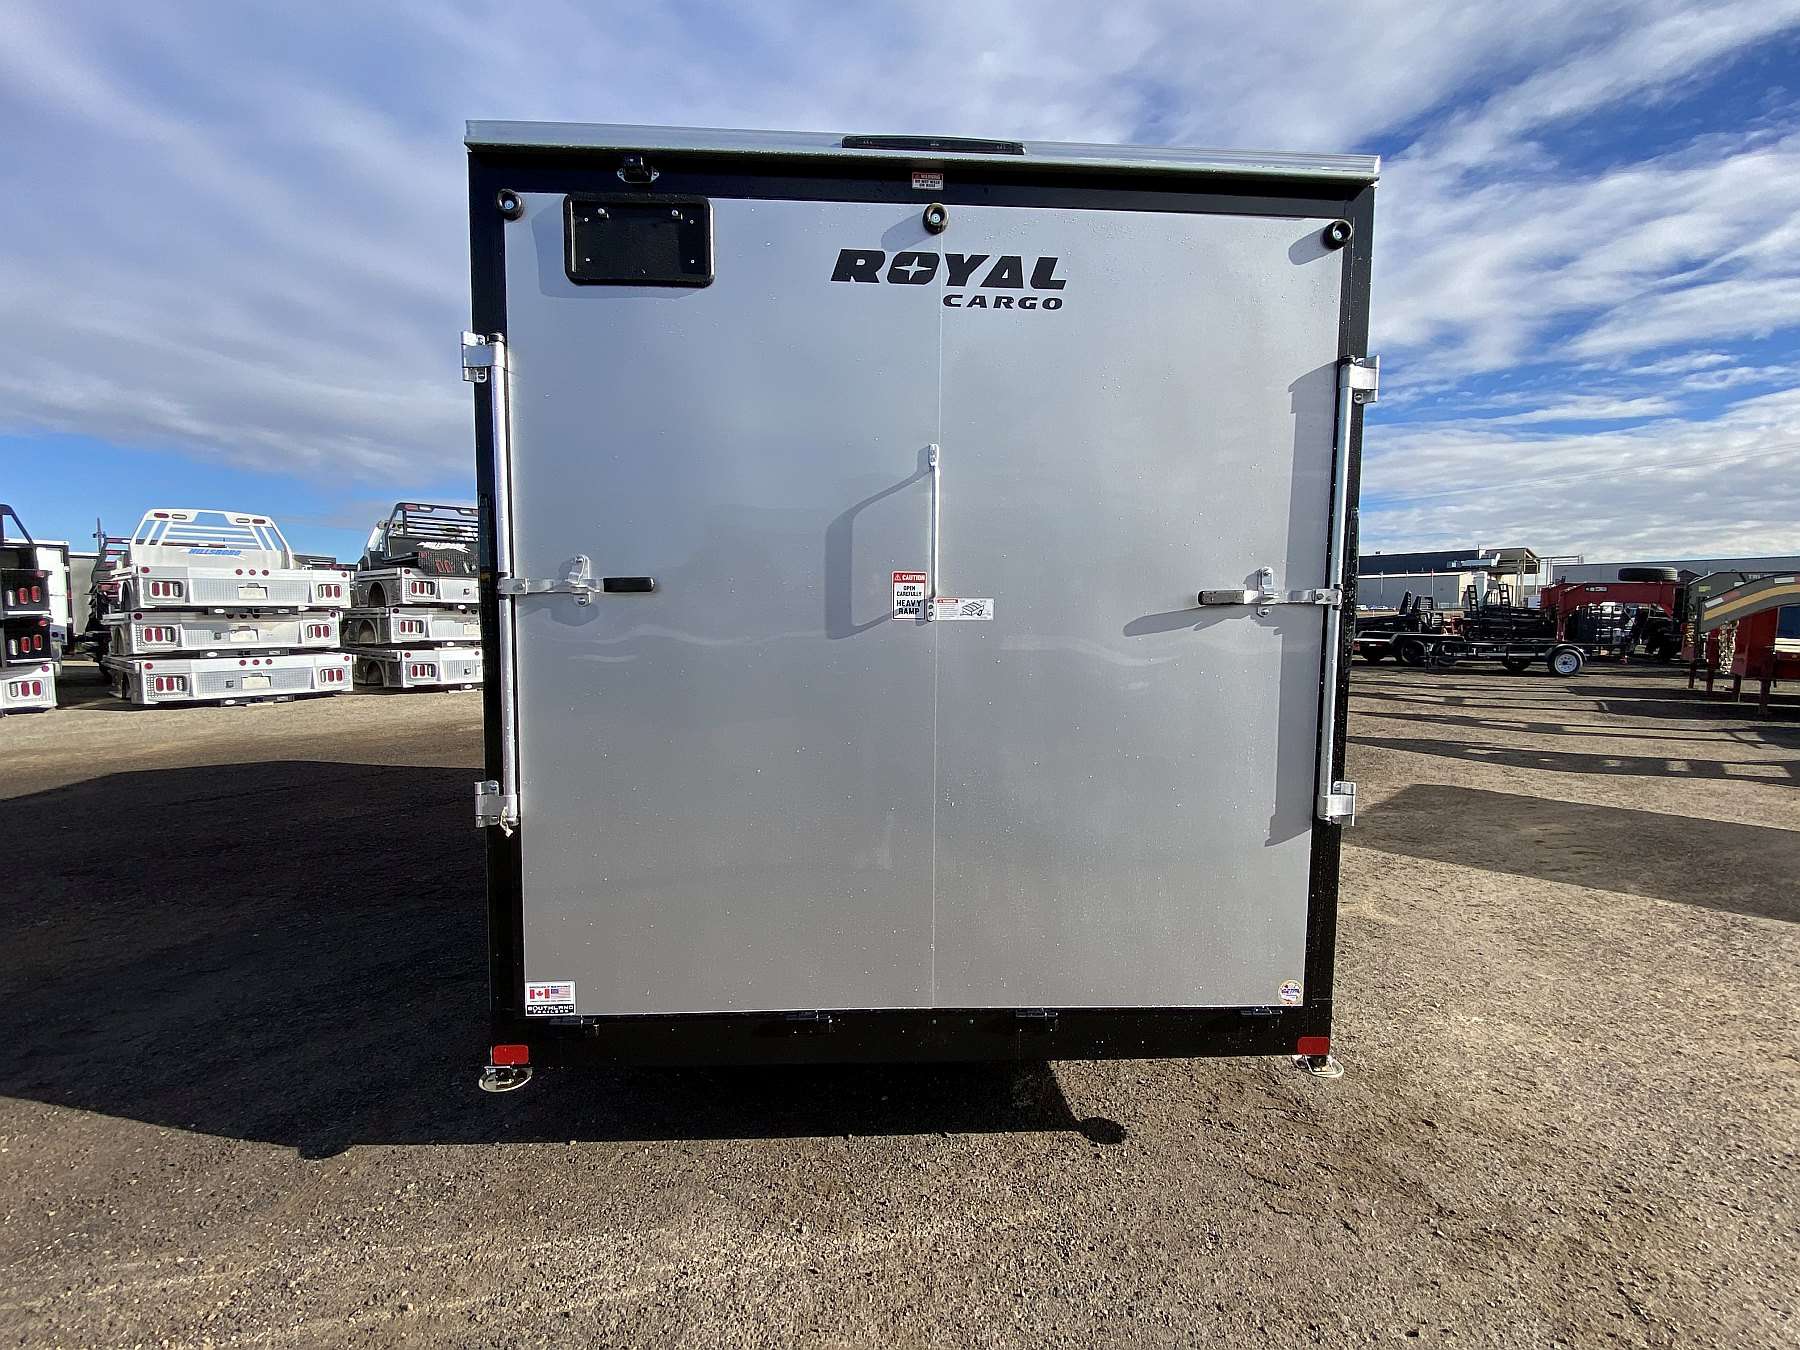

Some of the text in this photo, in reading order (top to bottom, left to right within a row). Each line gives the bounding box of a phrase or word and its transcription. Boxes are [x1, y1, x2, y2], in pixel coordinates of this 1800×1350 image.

[830, 249, 1067, 290] ROYAL
[943, 294, 1064, 310] CARGO
[896, 599, 922, 607] HEAVY
